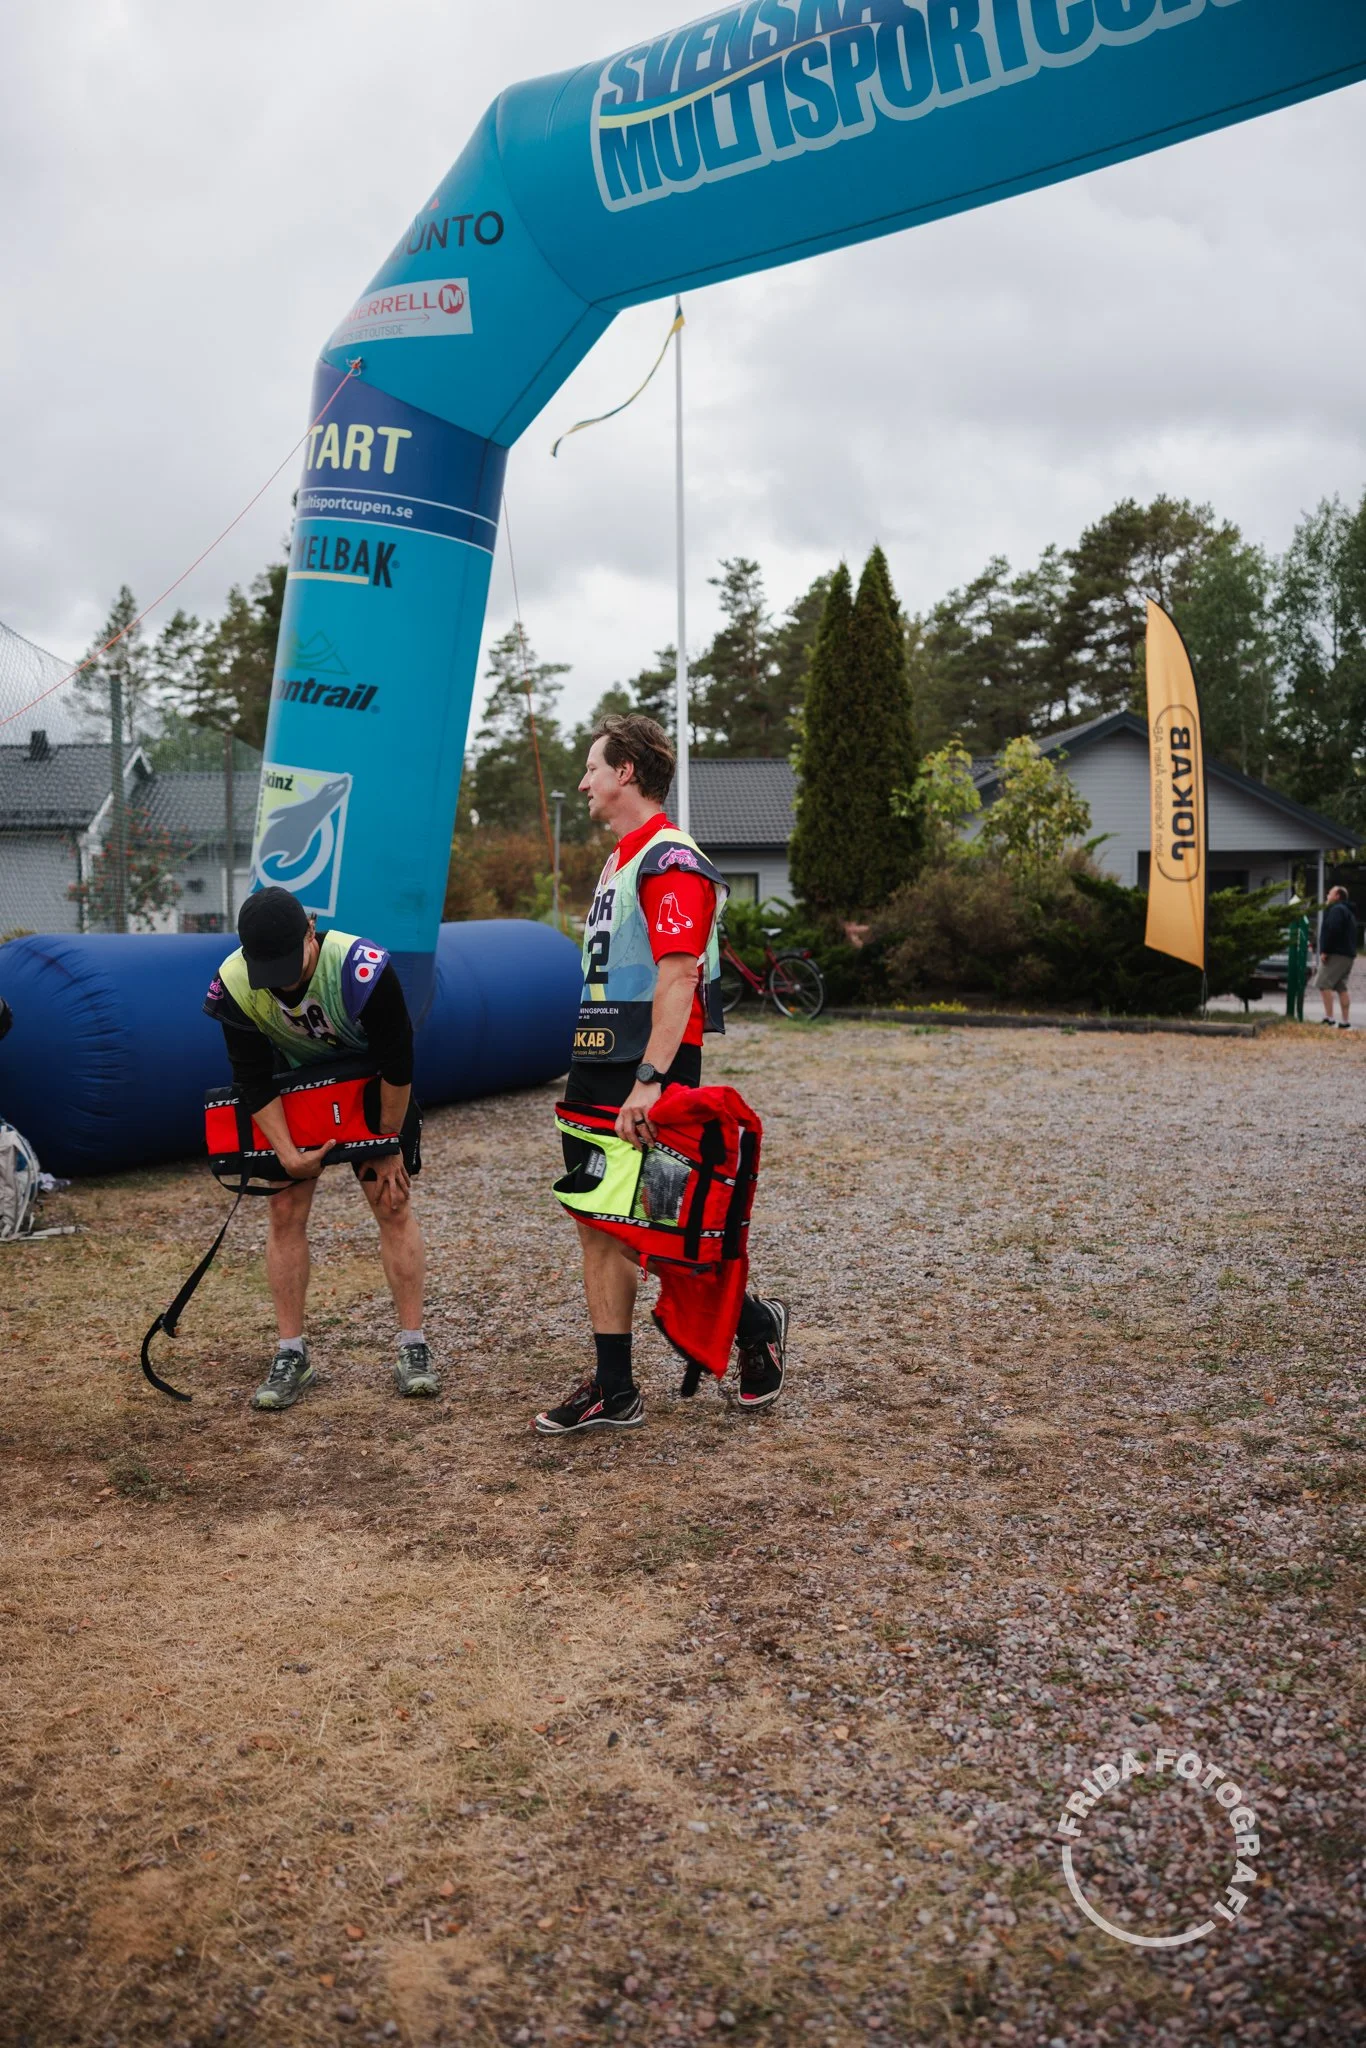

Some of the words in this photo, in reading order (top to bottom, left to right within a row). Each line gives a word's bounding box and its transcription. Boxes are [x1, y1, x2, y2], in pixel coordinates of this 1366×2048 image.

[573, 1031, 605, 1048] KAB
[280, 1077, 337, 1094] BALTIC
[557, 1117, 592, 1134] LTIC
[345, 1137, 400, 1150] BALTIC
[638, 1136, 691, 1165] ALTIC
[592, 1213, 650, 1228] BALTIC
